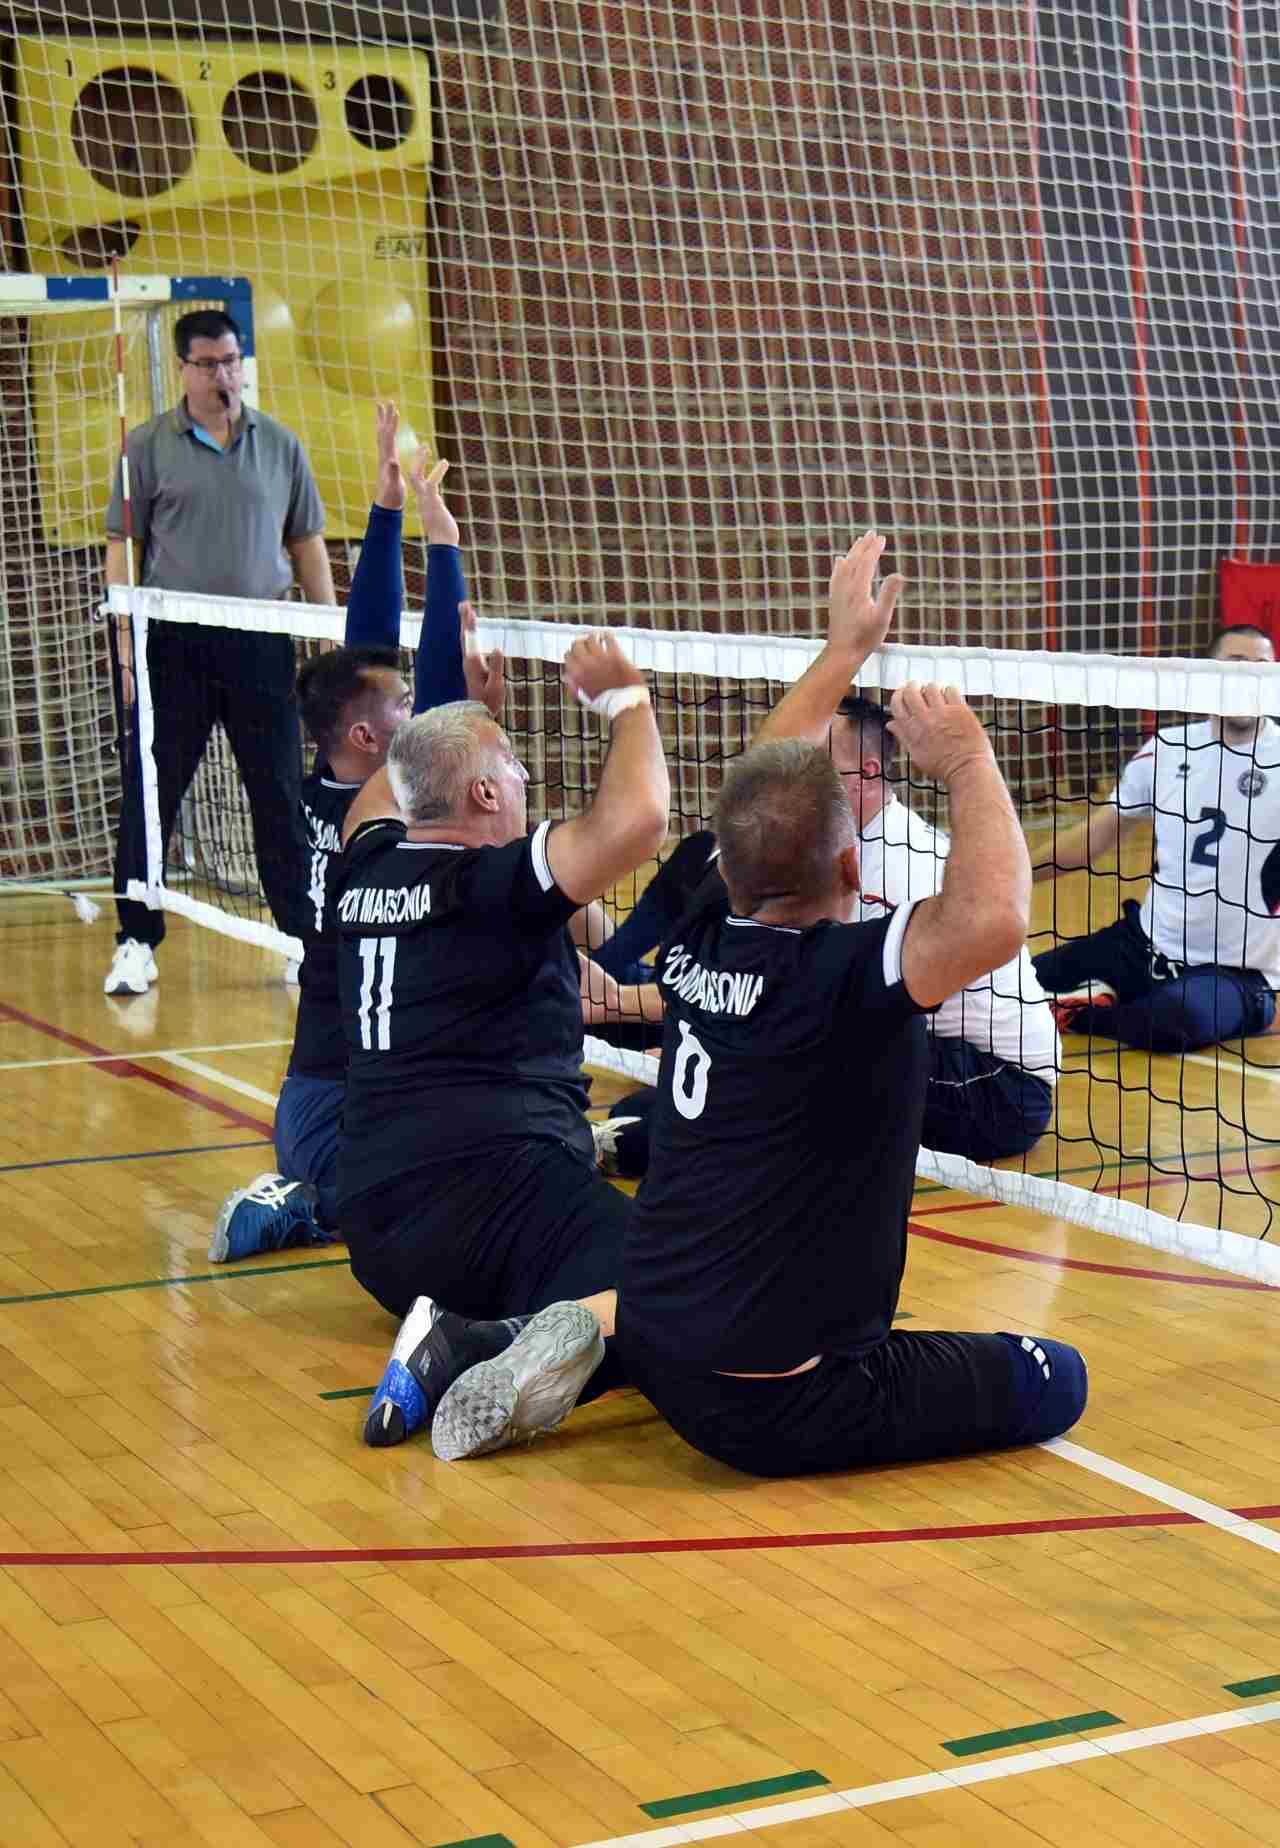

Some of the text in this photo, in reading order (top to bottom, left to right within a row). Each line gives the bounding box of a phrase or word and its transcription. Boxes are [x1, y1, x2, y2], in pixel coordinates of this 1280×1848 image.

[64, 59, 73, 78] 1
[199, 60, 211, 81] 2
[323, 71, 337, 91] 3
[1190, 807, 1227, 868] 2
[358, 937, 397, 1050] 11
